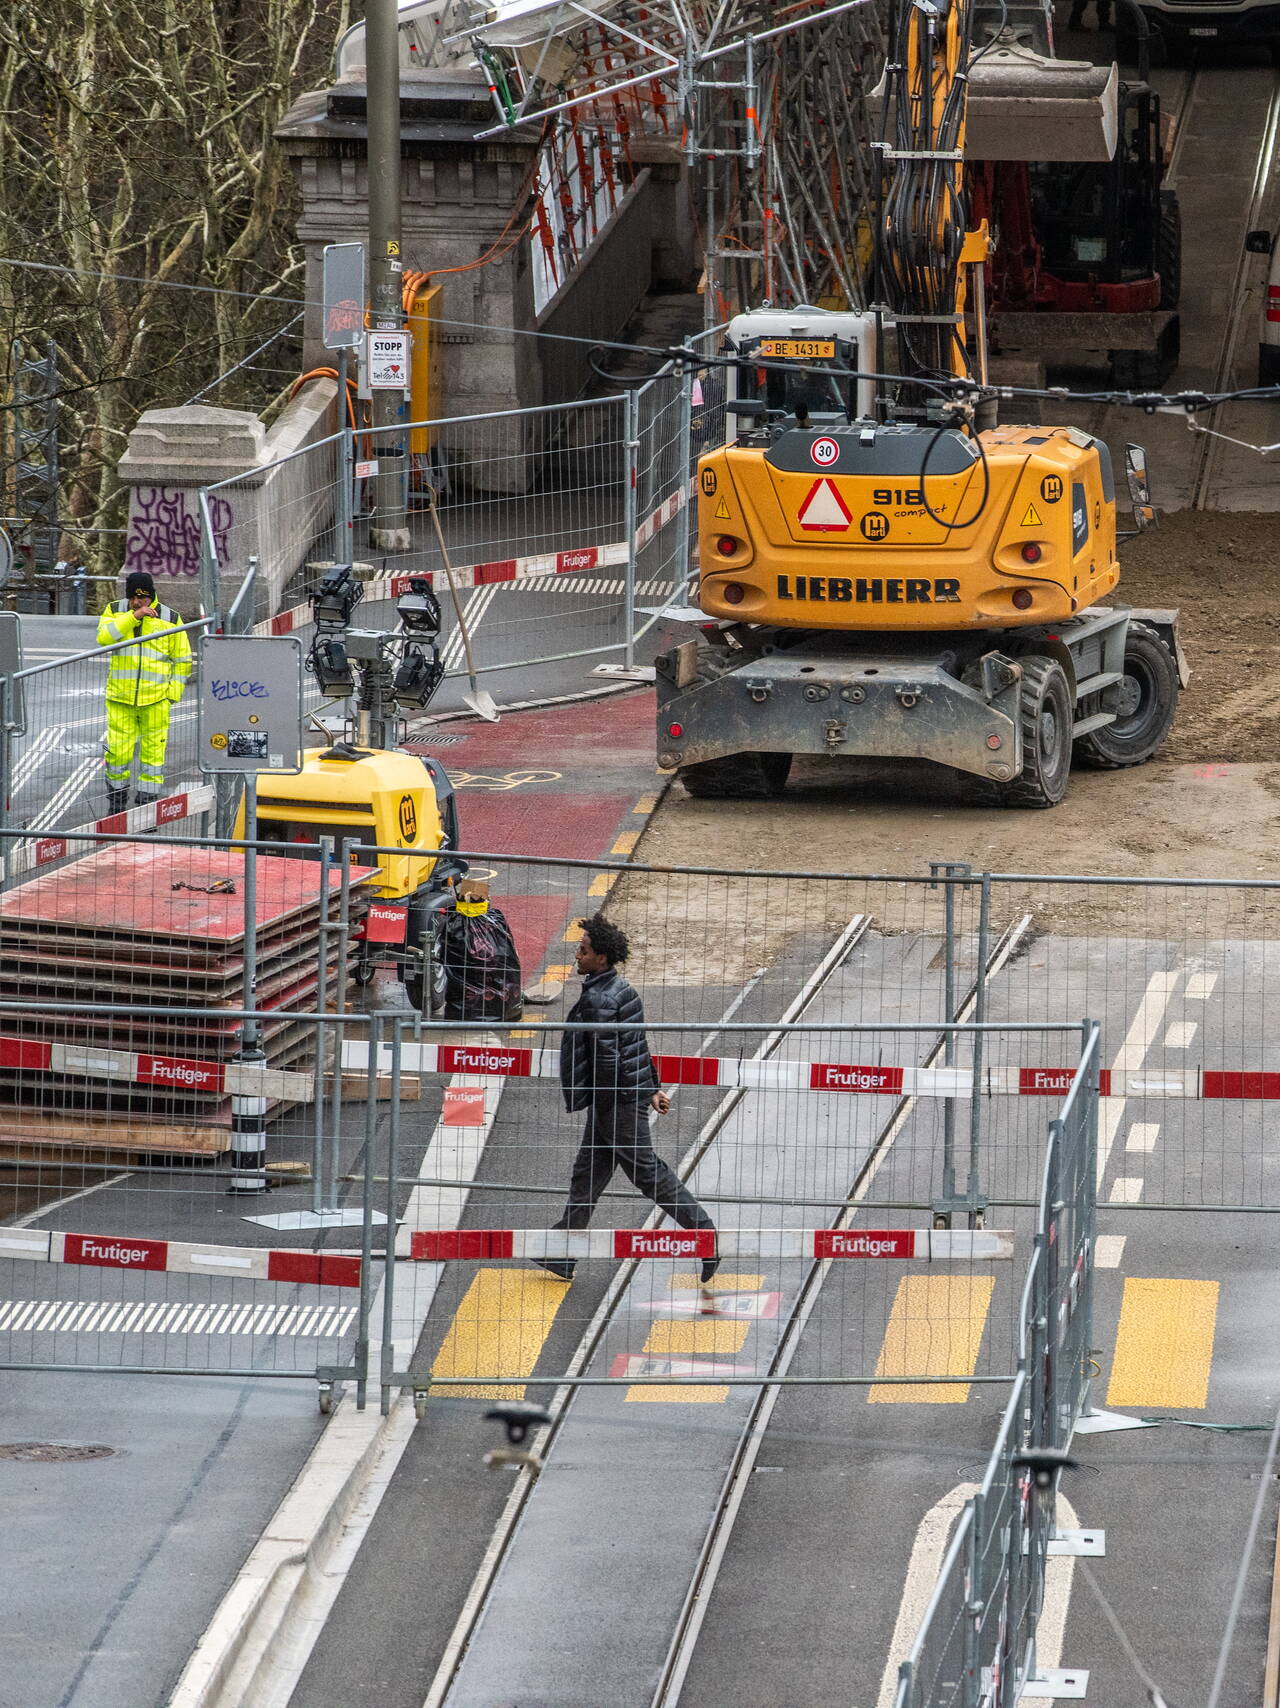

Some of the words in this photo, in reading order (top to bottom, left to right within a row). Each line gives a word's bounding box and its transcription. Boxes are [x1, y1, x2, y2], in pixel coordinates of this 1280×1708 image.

[374, 342, 402, 351] STOPP
[818, 445, 832, 457] 30
[873, 489, 923, 505] 918
[563, 554, 591, 569] Frutiger
[776, 574, 962, 603] LIEBHERR
[370, 908, 406, 921] Frutiger
[453, 1049, 516, 1070] Frutiger
[152, 1060, 210, 1085] Frutiger
[826, 1069, 887, 1088] Frutiger
[444, 1091, 484, 1104] Frutiger
[82, 1240, 149, 1264] Frutiger
[631, 1235, 697, 1256] Frutiger
[831, 1236, 898, 1257] Frutiger
